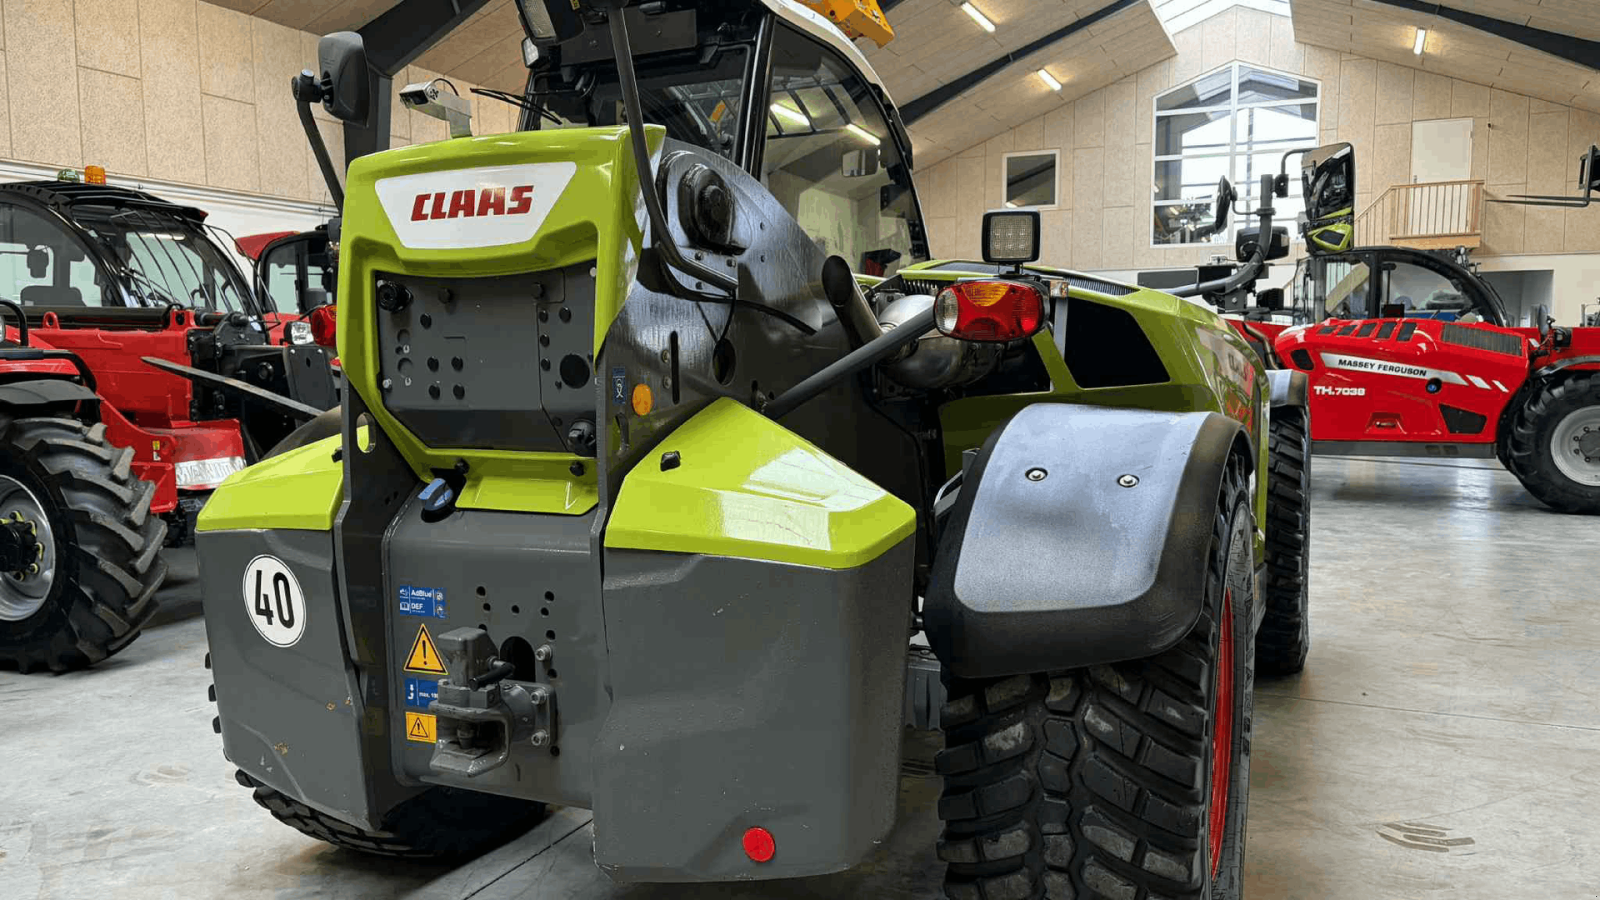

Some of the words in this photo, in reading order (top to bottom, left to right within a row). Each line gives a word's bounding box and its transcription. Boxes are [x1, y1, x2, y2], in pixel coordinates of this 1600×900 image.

[411, 185, 534, 221] CLAAS
[1338, 359, 1376, 370] MASSEY
[1377, 363, 1427, 376] FERGUSON
[1313, 386, 1366, 396] TH.7038
[255, 570, 295, 630] 40
[411, 589, 432, 598] AdBlue
